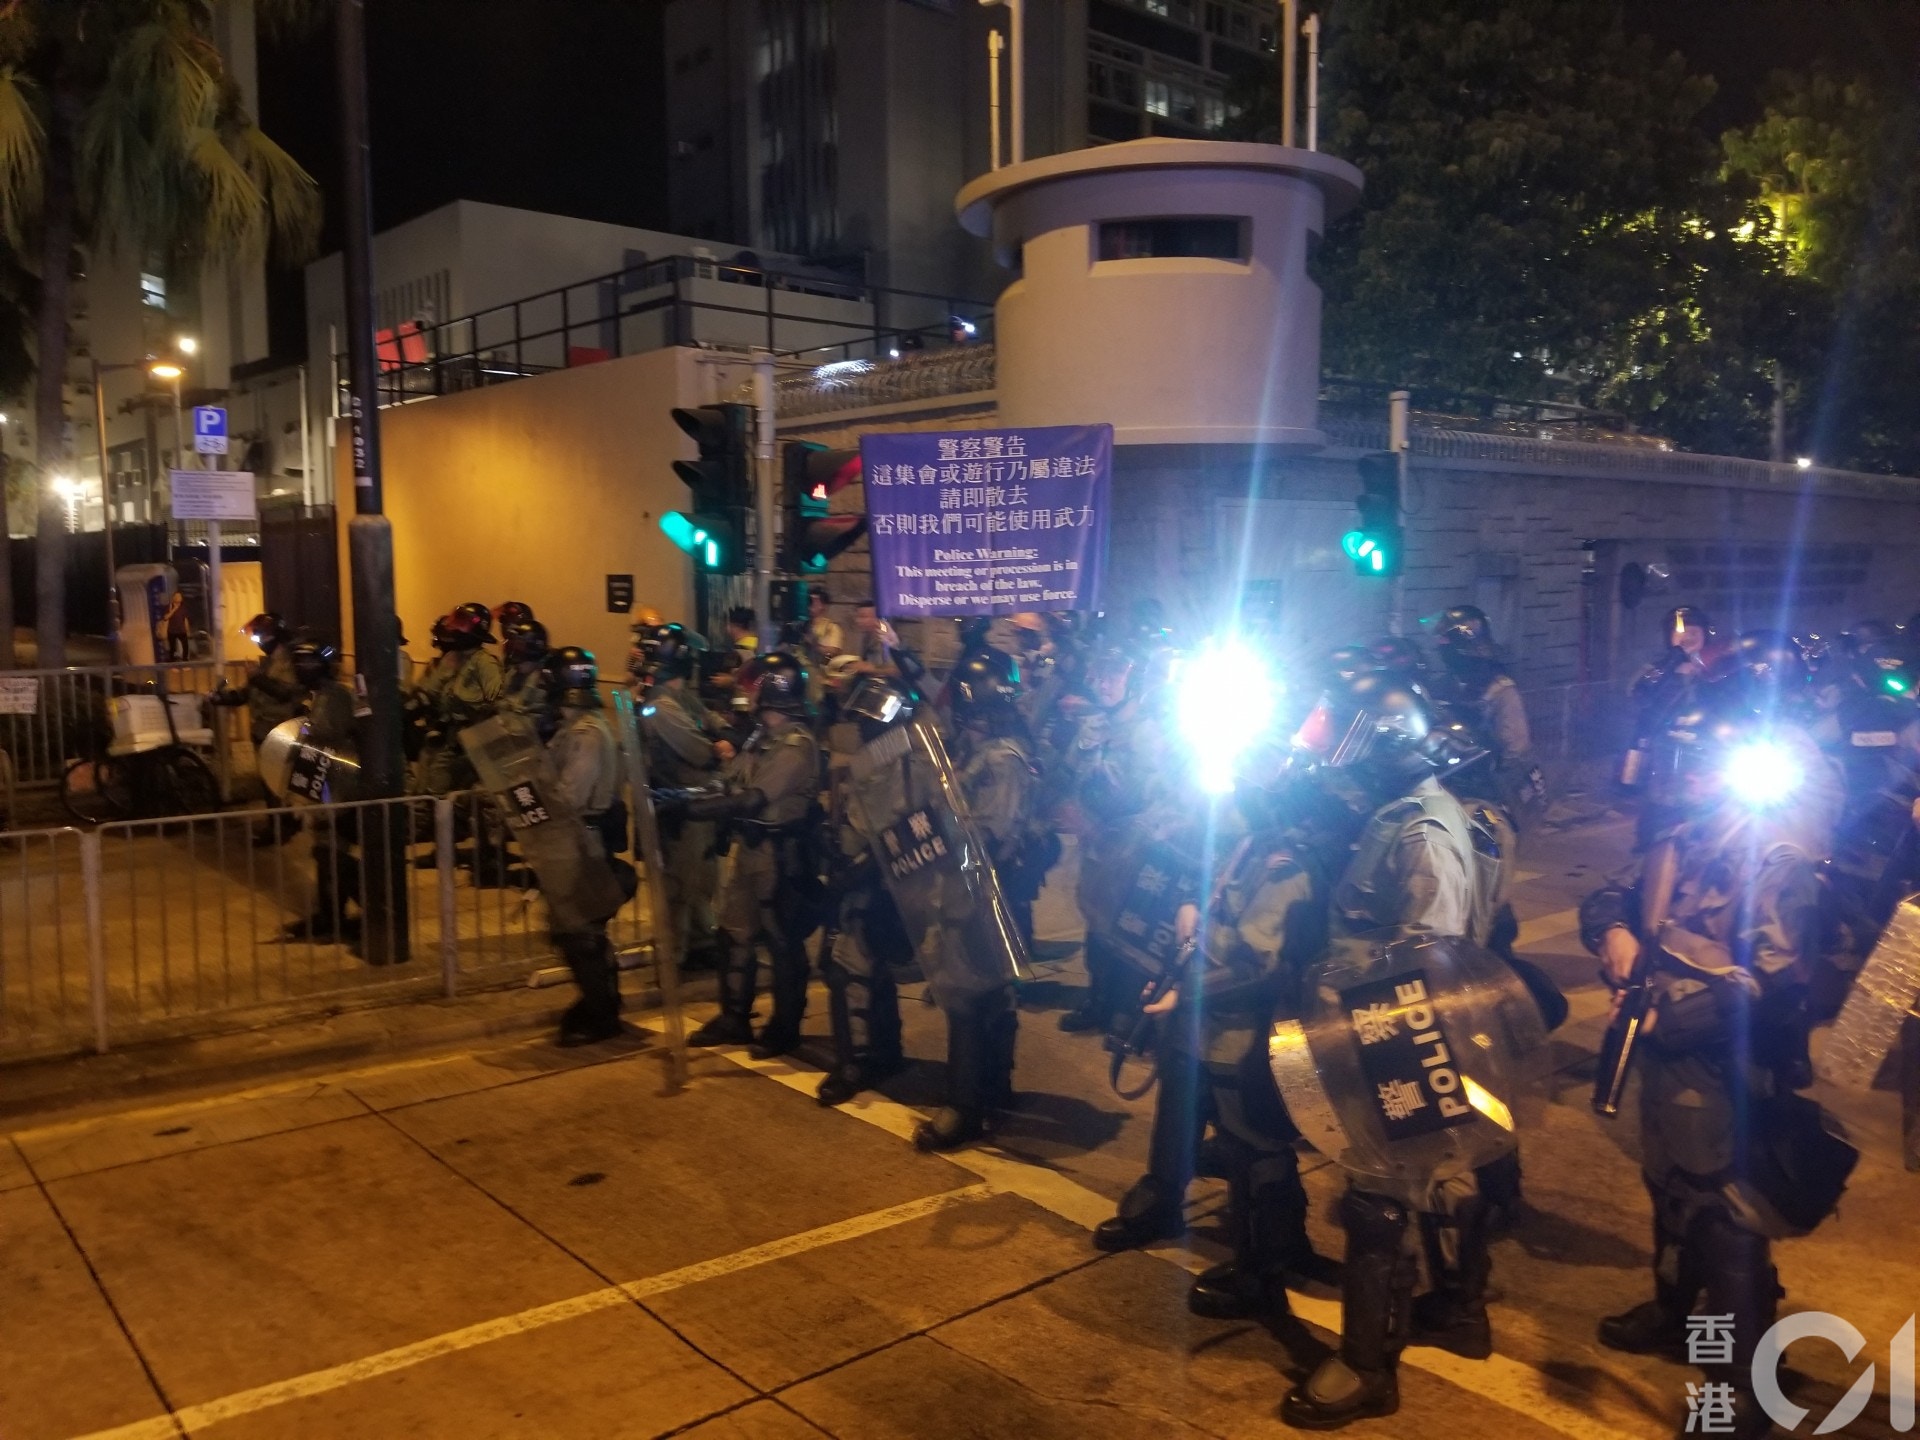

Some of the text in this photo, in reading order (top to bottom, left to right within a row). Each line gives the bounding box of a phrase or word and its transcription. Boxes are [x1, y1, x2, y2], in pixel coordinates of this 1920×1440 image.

[200, 410, 220, 433] P
[938, 435, 1027, 459] 警察警告
[872, 455, 1096, 486] 這集會或遊行乃屬違法
[940, 485, 1028, 509] 請即散去
[873, 505, 1095, 535] 否則我們可能使用武力
[934, 546, 1039, 561] Police Warning:
[896, 559, 1079, 579] This meeting or procession is in
[935, 576, 1042, 592] breach of the law.
[899, 588, 1078, 609] Disperse or we may use force.
[891, 835, 947, 878] POLICE
[1394, 979, 1471, 1118] POLICE
[1352, 1002, 1428, 1120] 警察
